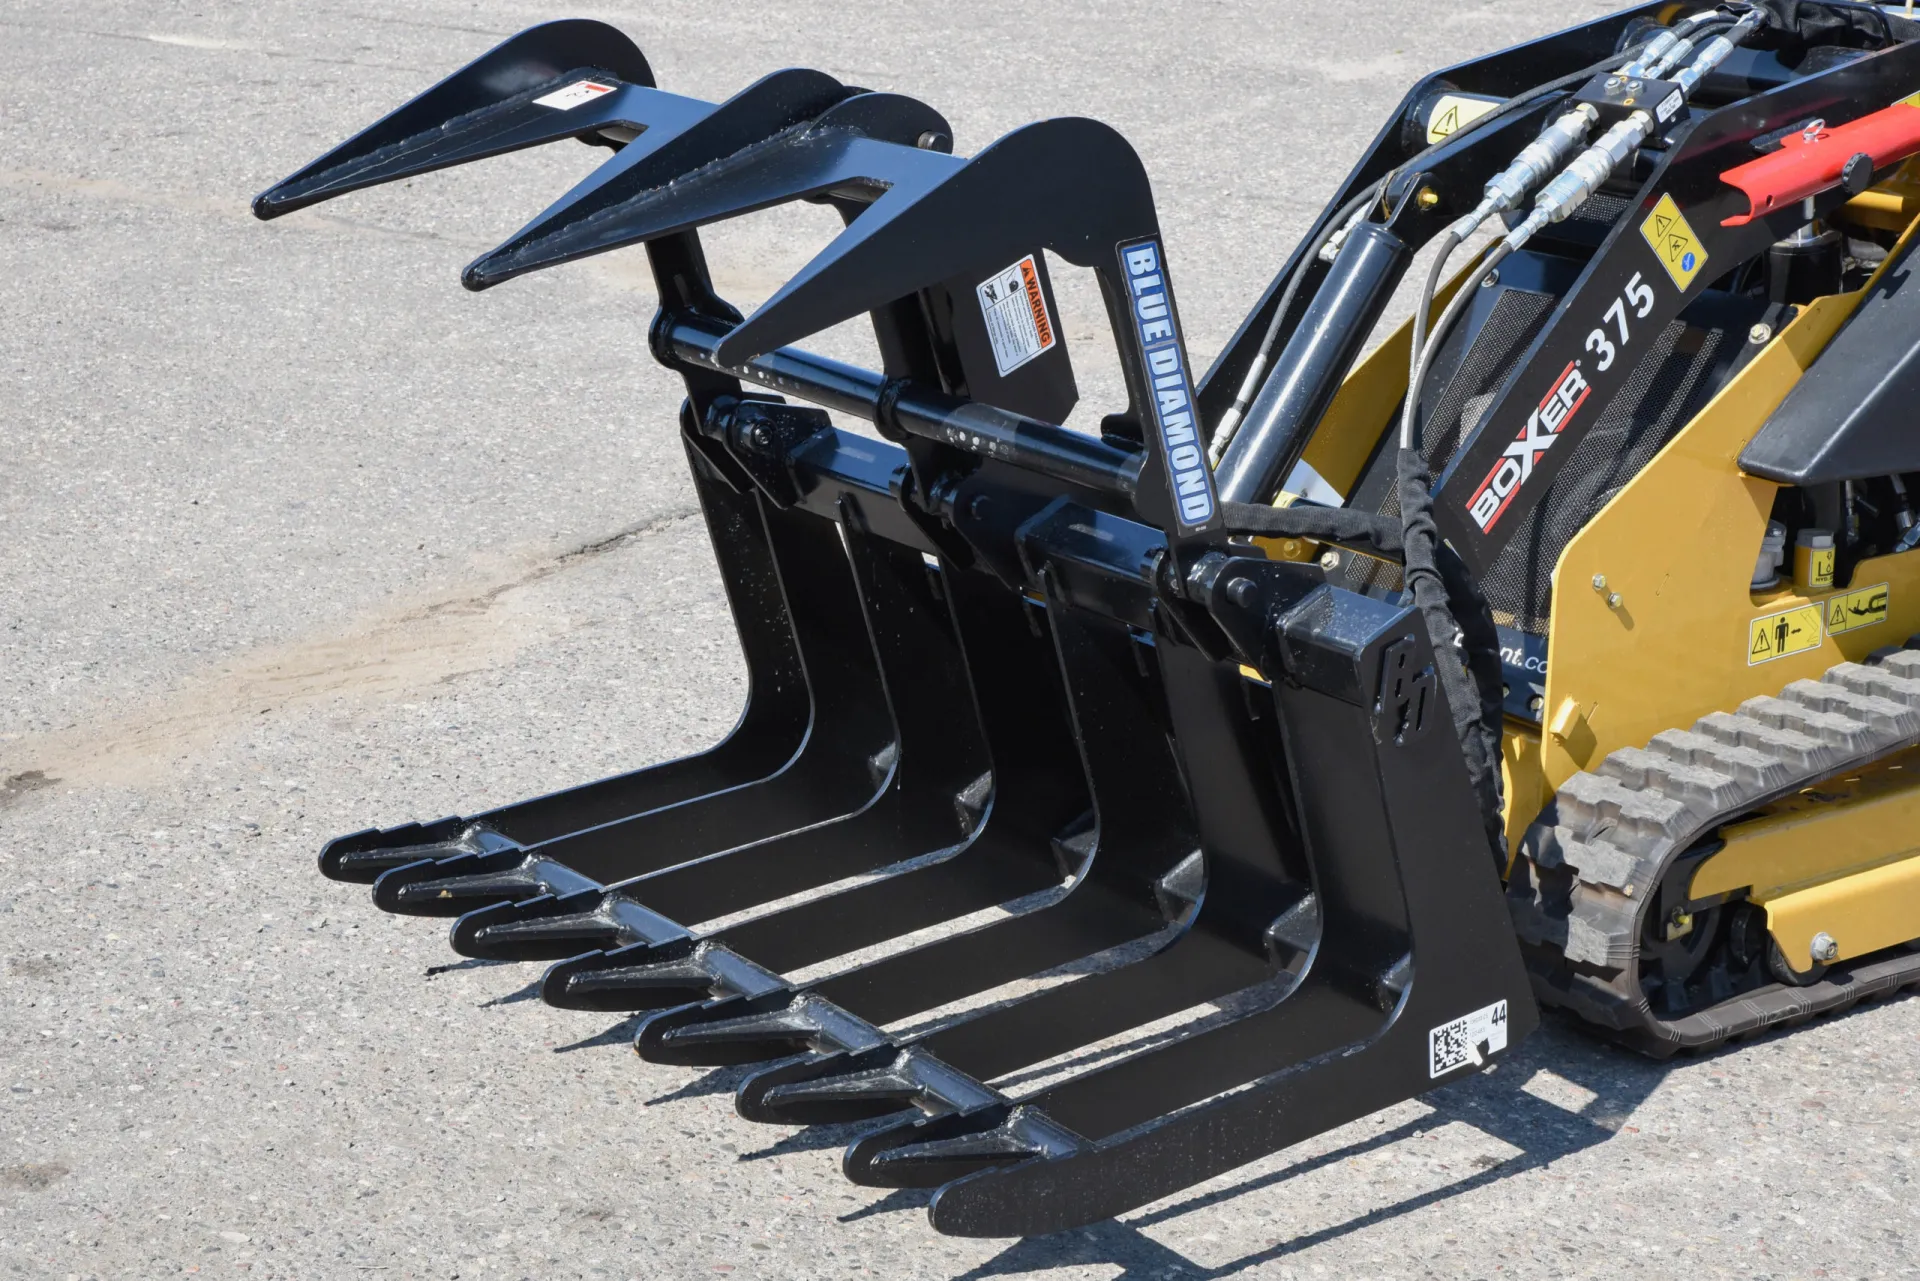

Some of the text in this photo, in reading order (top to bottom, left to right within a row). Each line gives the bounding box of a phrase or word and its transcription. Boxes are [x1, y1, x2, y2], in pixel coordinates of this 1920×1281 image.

[1025, 276, 1051, 343] WARNING
[1126, 246, 1211, 521] BLUE DIAMOND
[1469, 271, 1655, 529] BOXER 375
[1491, 1004, 1506, 1026] 44
